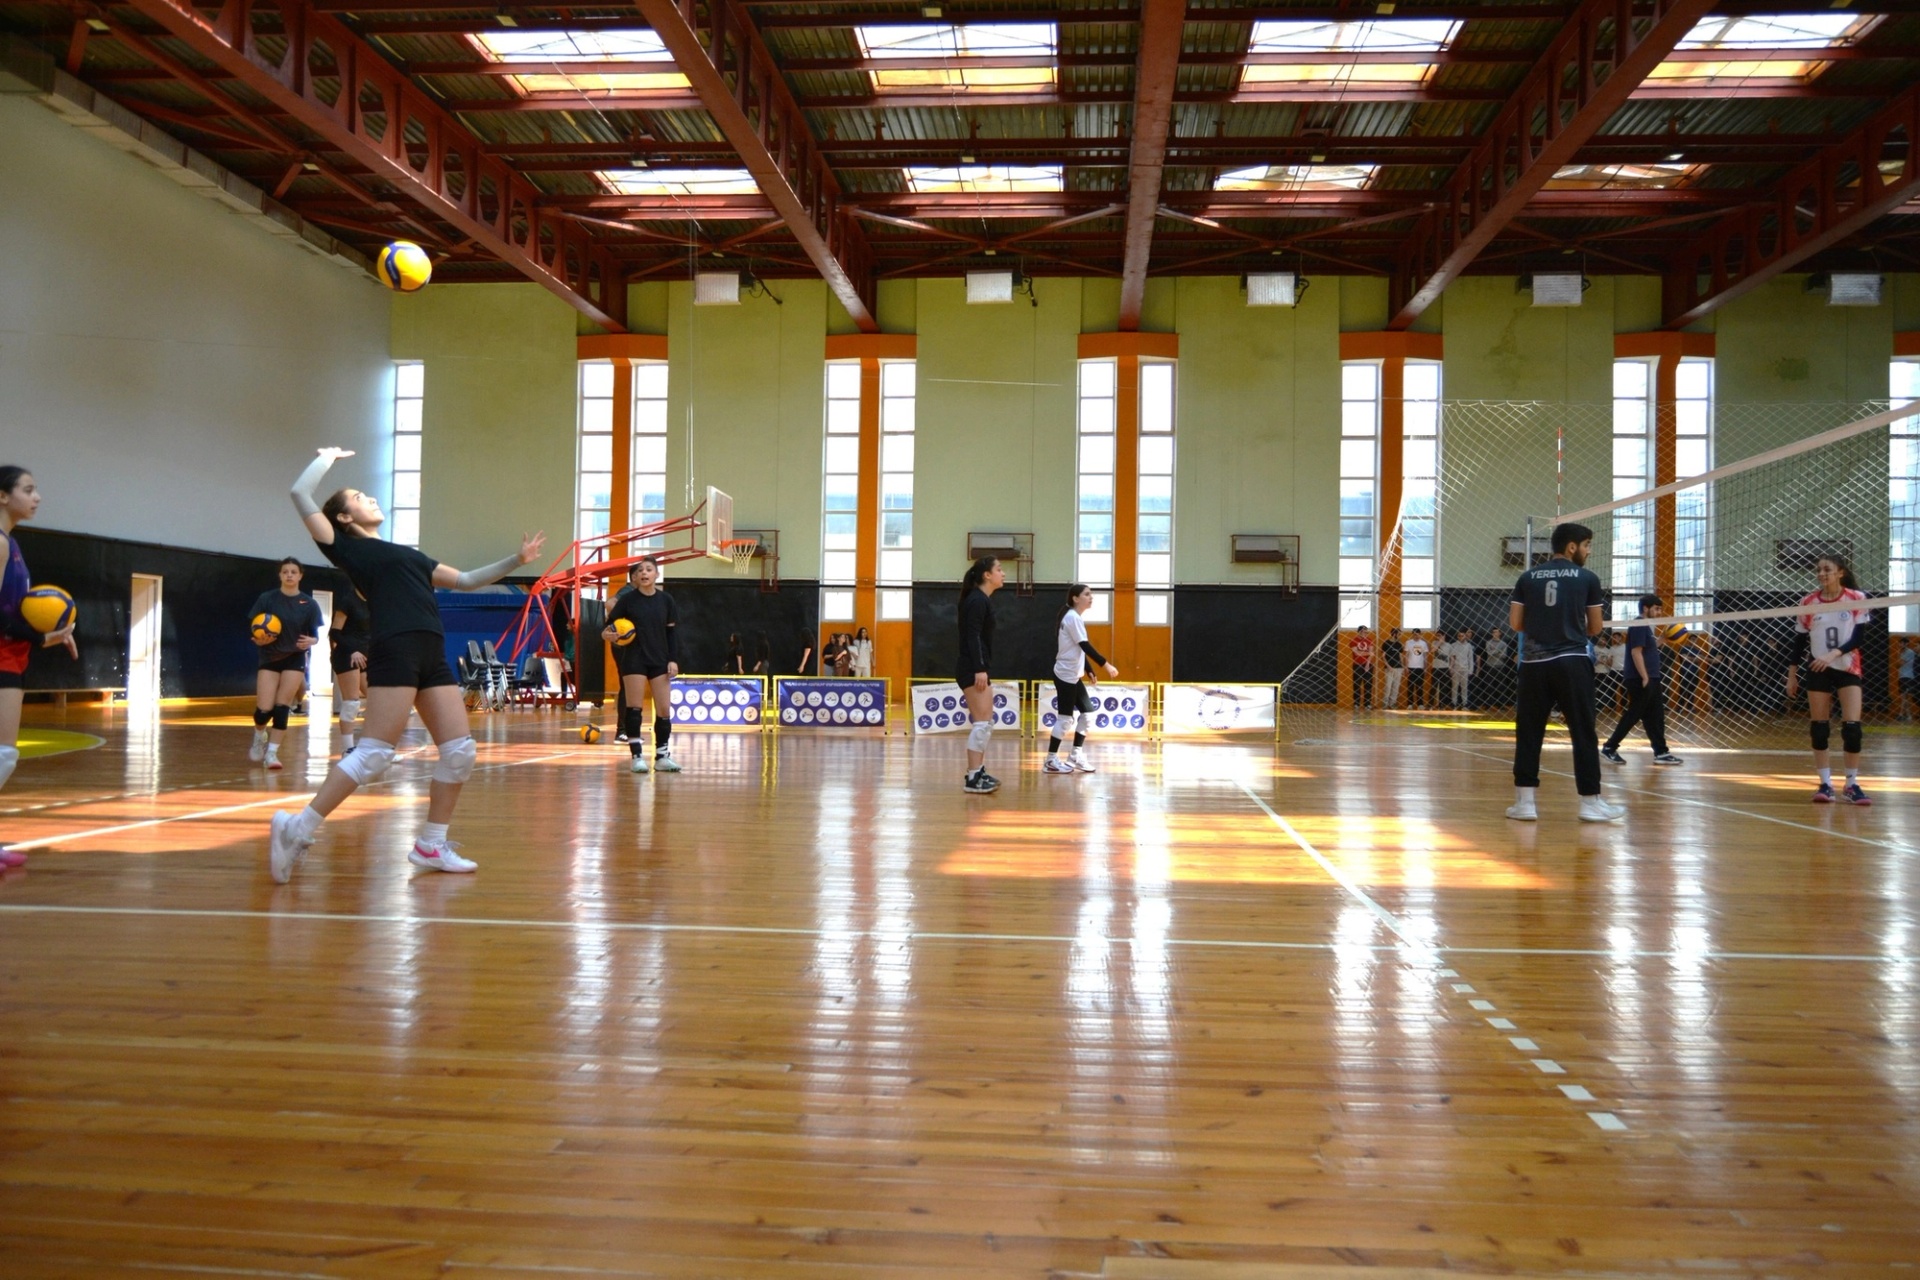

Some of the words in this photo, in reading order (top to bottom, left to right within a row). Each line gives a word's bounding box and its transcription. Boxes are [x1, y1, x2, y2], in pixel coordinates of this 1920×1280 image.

[1530, 568, 1579, 579] YEREVAN
[1545, 580, 1558, 607] 6
[1826, 626, 1839, 649] 9
